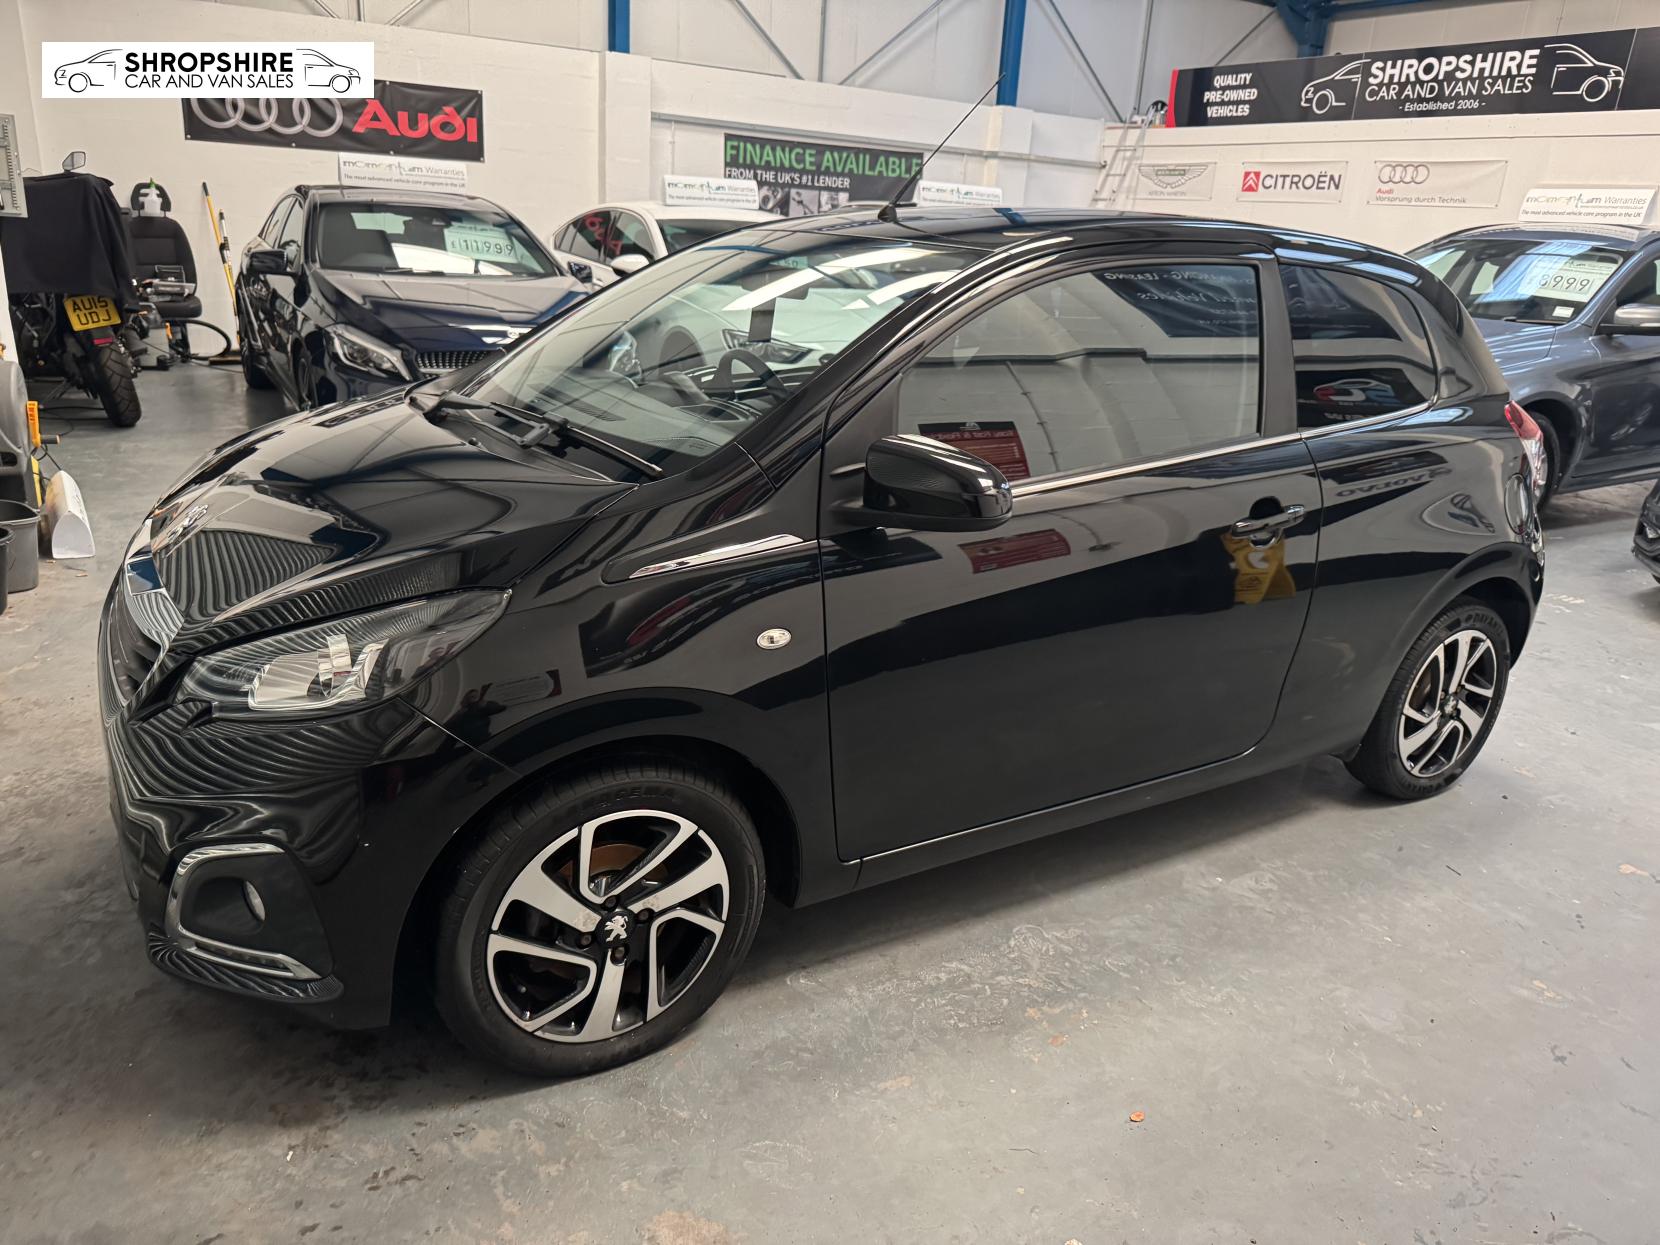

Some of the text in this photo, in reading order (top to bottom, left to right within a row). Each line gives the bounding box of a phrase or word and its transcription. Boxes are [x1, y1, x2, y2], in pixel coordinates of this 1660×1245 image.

[1368, 49, 1540, 85] SHROPSHIRE
[1214, 73, 1252, 88] QUALITY
[1365, 76, 1533, 101] CAR AND VAN SALES
[1203, 88, 1258, 103] PRE-OWNED
[1207, 104, 1250, 118] VEHICLES
[1404, 100, 1455, 112] Established
[1457, 99, 1479, 110] 2006
[352, 98, 478, 142] Audi
[725, 140, 922, 179] FINANCE AVAILABLE
[726, 167, 850, 188] FROM THE UK'S #1 LENDER
[1261, 171, 1341, 191] CITROËN
[1438, 196, 1467, 204] Technik
[1604, 196, 1647, 205] Warranties
[72, 296, 108, 312] AU15
[77, 309, 112, 326] UDJ
